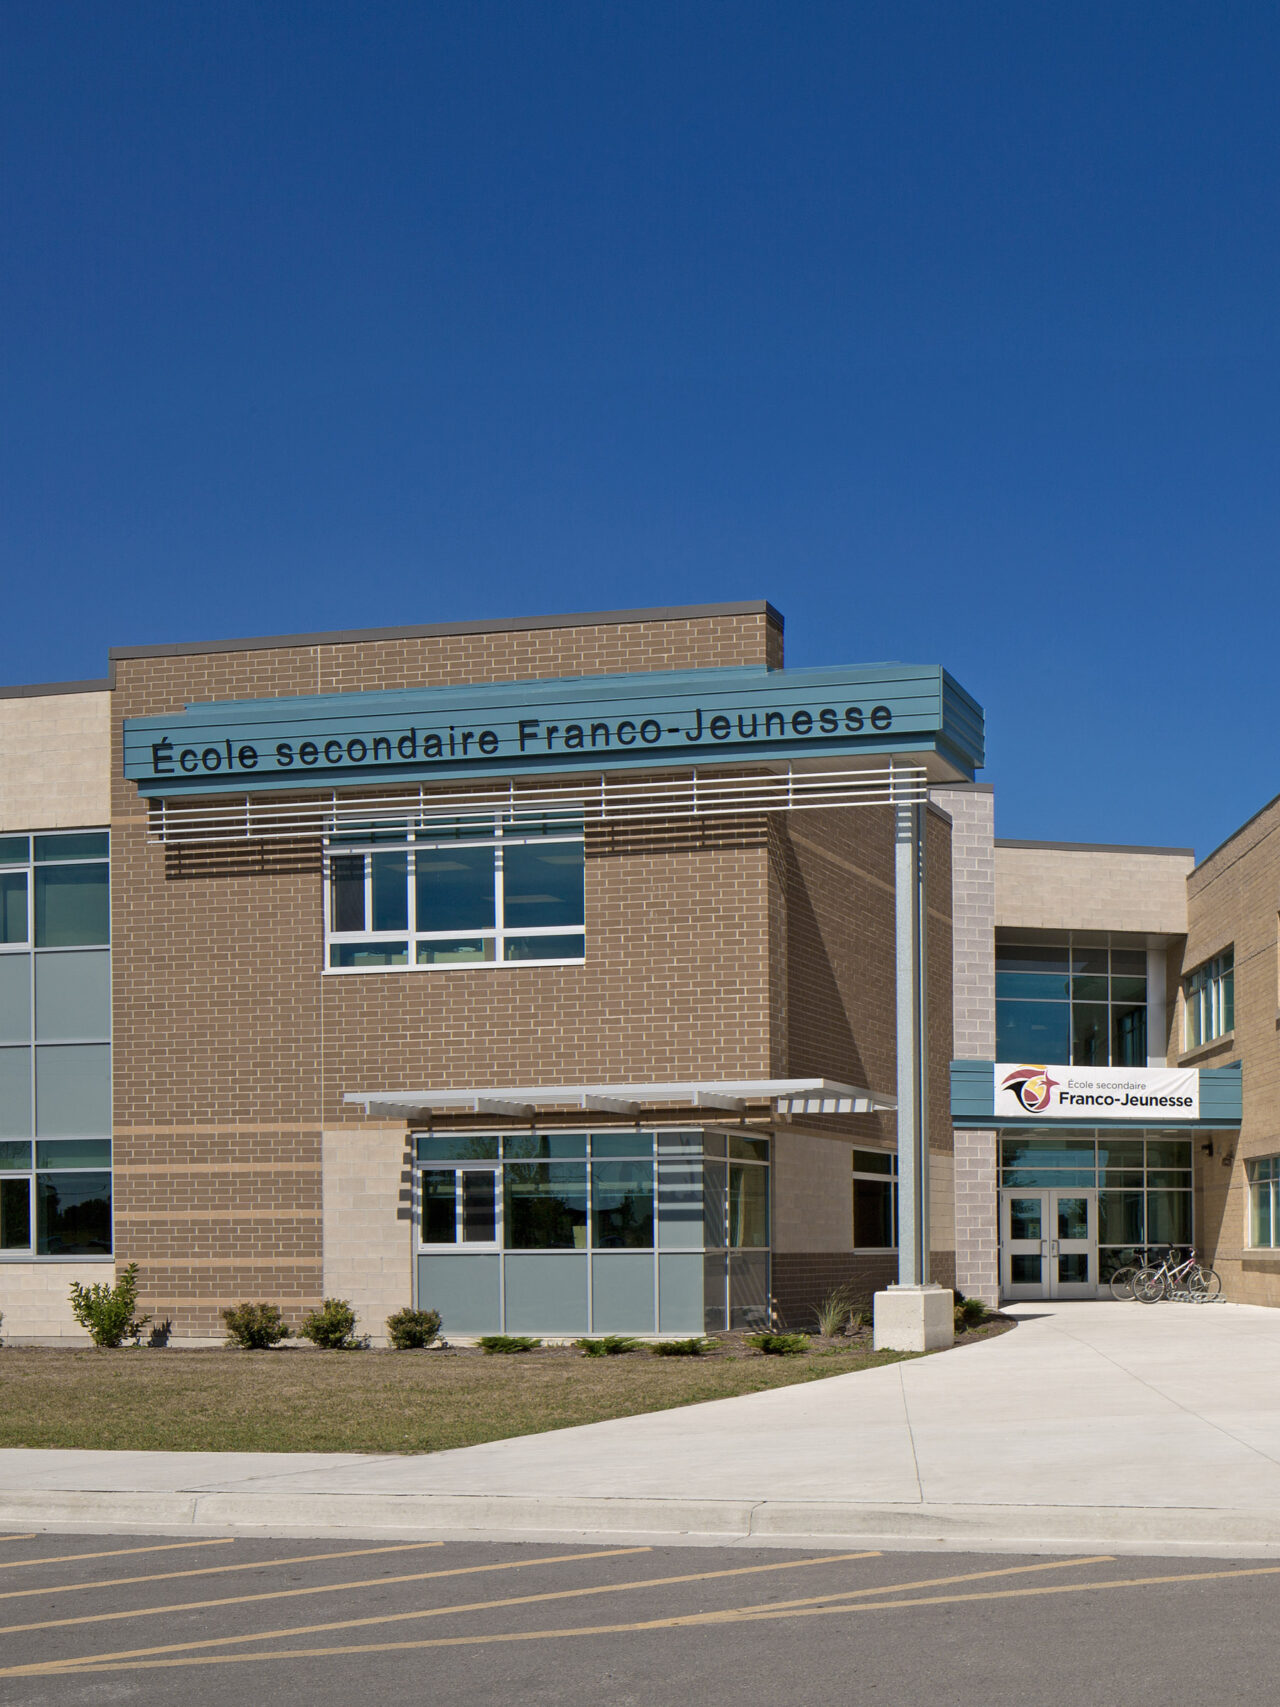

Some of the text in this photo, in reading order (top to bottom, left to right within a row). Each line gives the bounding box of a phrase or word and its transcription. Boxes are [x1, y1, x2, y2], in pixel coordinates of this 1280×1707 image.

[151, 705, 893, 774] École secondaire Franco-Jeunesse
[1067, 1079, 1147, 1090] École secondaire
[1059, 1091, 1193, 1107] Franco-Jeunesse
